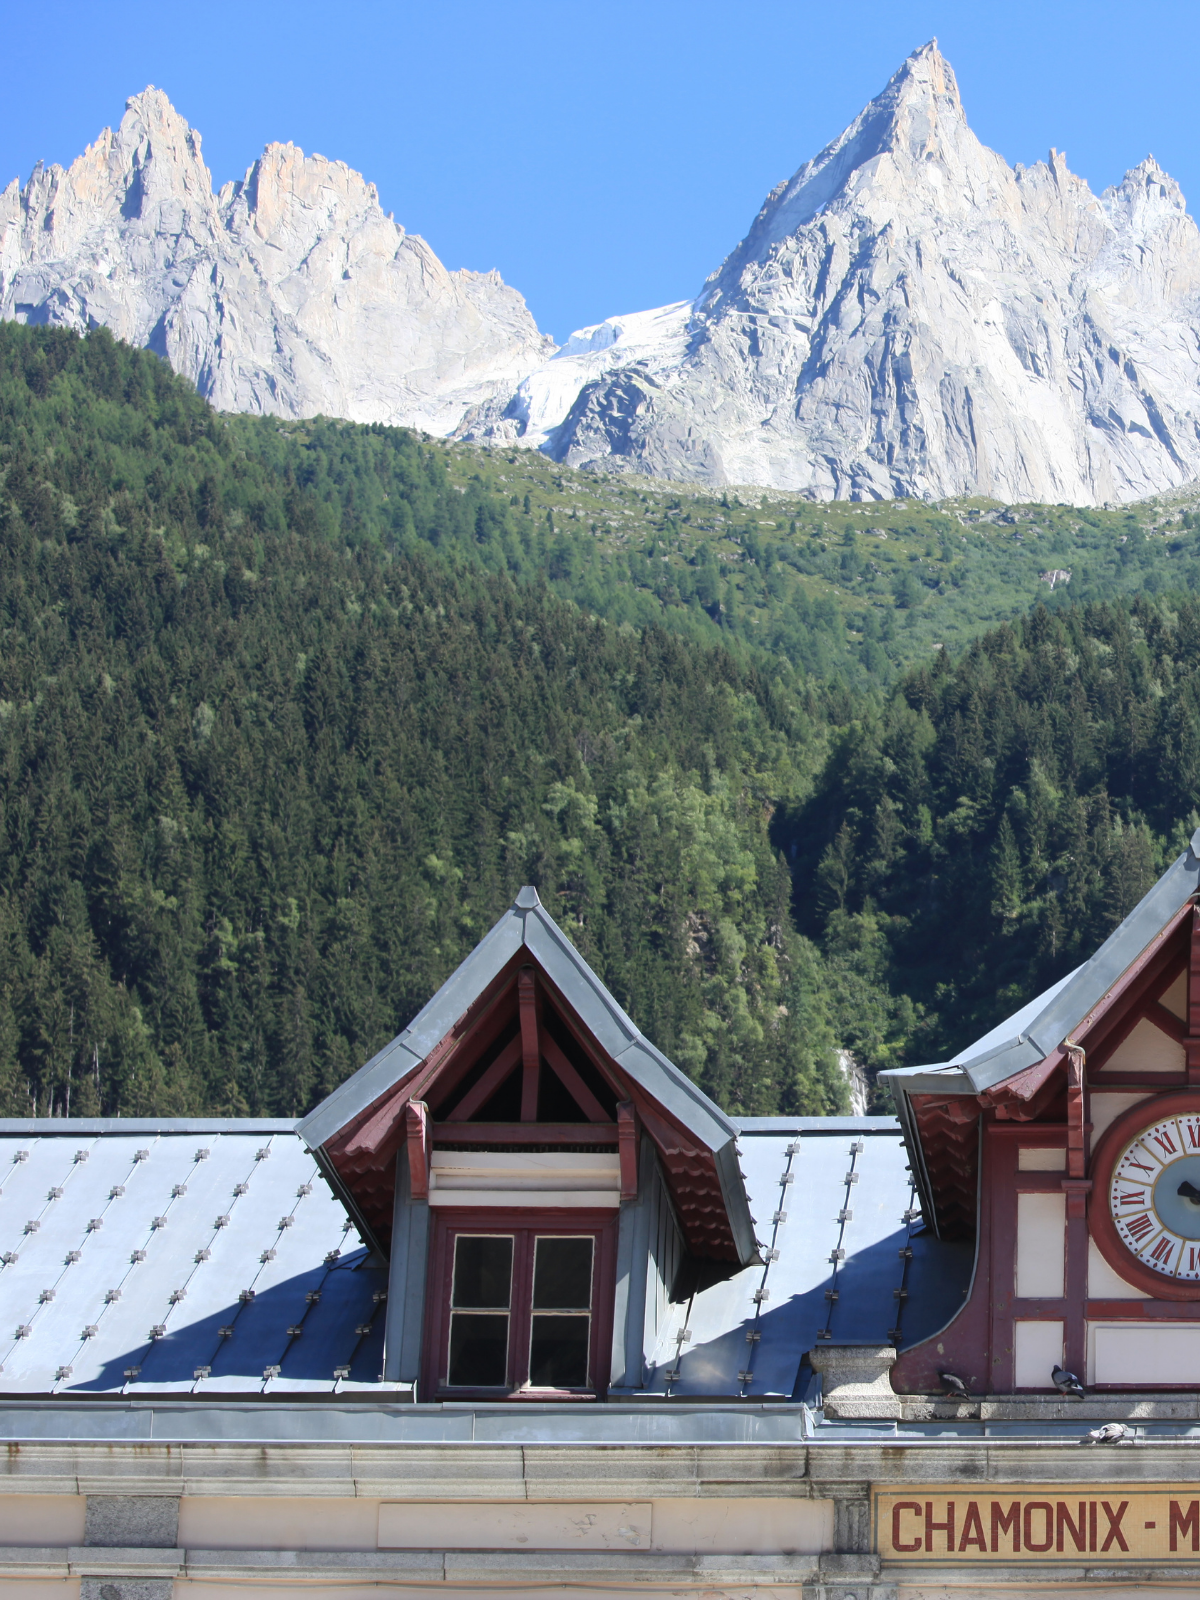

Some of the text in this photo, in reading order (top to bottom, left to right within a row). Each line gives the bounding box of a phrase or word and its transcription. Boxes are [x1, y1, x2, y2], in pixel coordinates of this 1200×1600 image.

[1152, 1131, 1178, 1158] XI
[1128, 1156, 1155, 1178] X
[1119, 1189, 1145, 1206] IX
[1125, 1213, 1155, 1243] VIII
[1149, 1236, 1176, 1266] VII
[892, 1501, 1130, 1553] CHAMONIX
